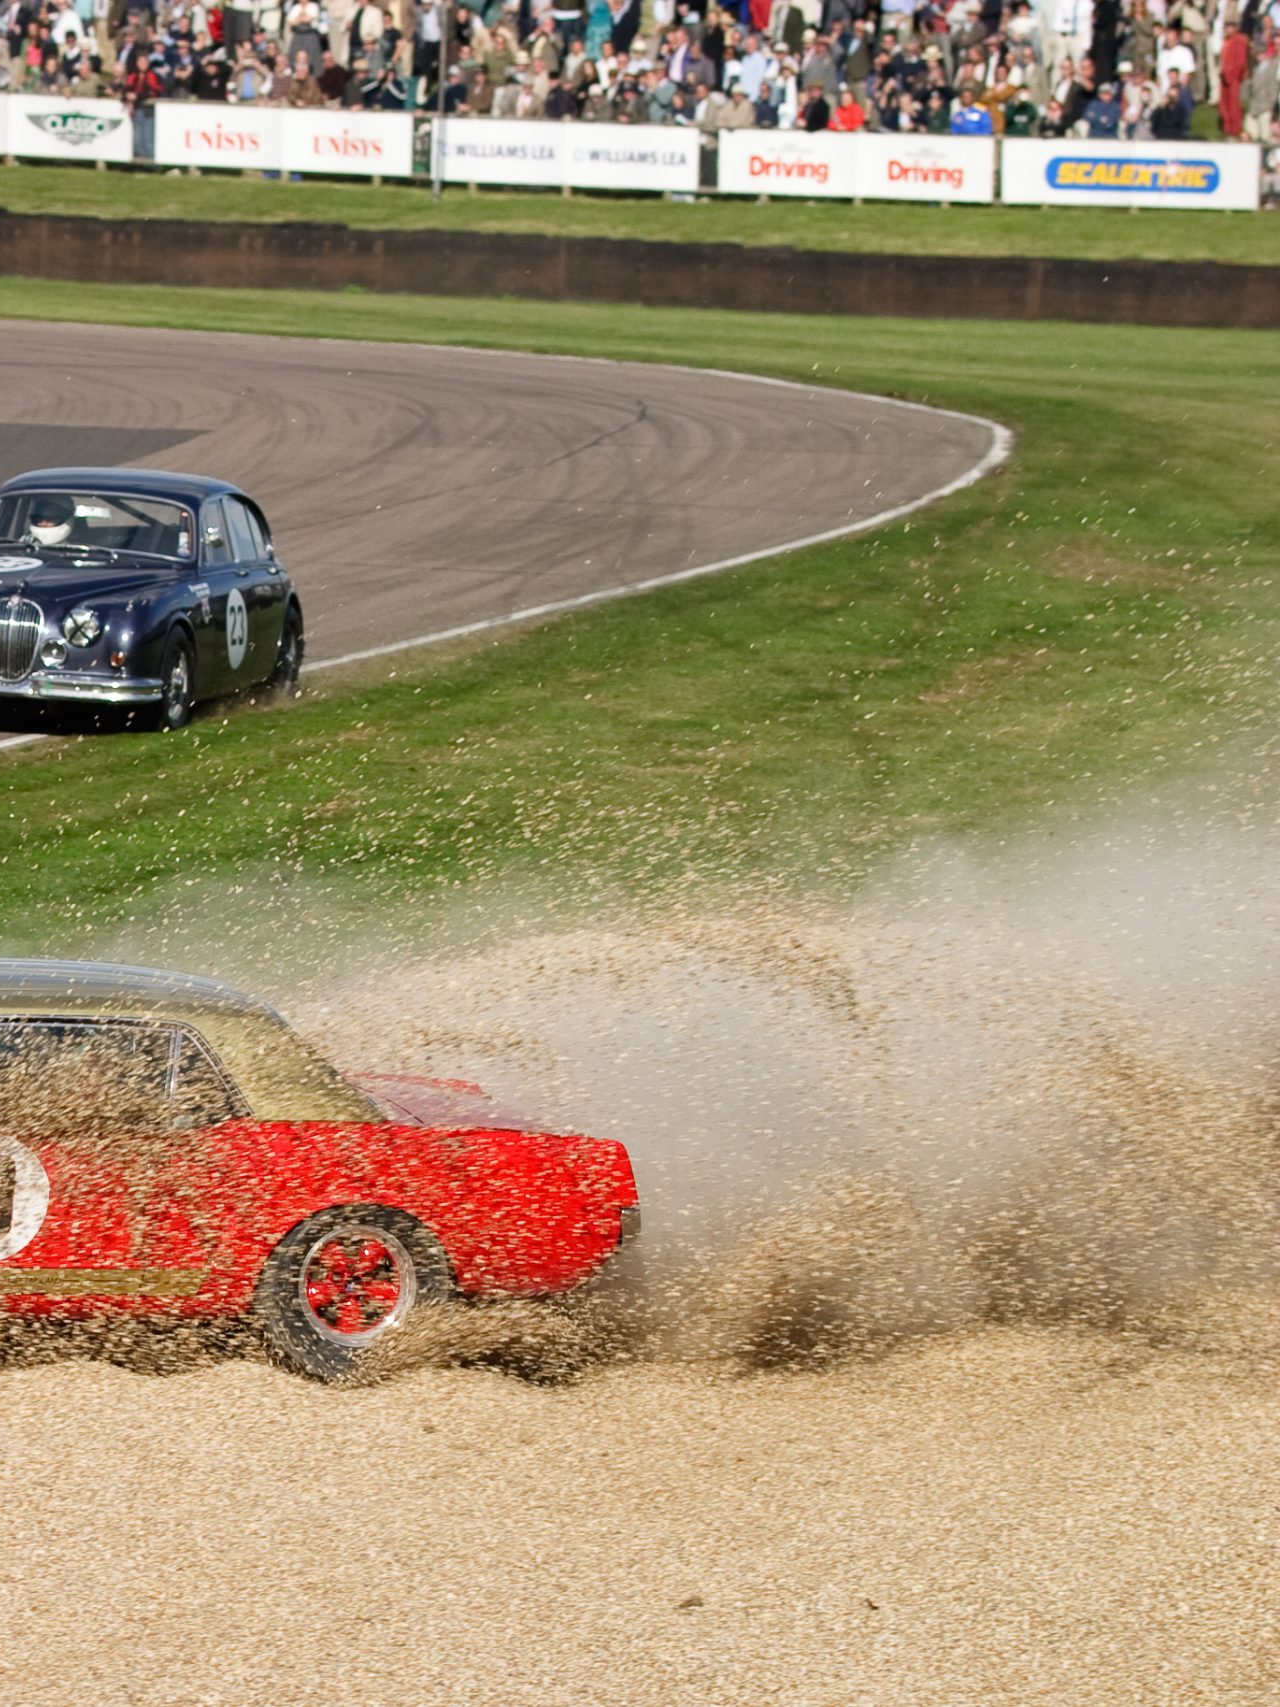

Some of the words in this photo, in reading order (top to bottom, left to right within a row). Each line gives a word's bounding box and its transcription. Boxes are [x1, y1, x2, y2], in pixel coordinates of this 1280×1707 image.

[44, 113, 111, 136] CLASSIC
[455, 144, 528, 160] WILLIAMS
[531, 145, 556, 161] LEA
[588, 147, 659, 165] WILLIAMS
[661, 150, 688, 166] LEA
[748, 155, 830, 184] Driving
[887, 159, 964, 188] Driving
[1055, 162, 1215, 188] SCALEXTRIC
[229, 604, 245, 647] 23
